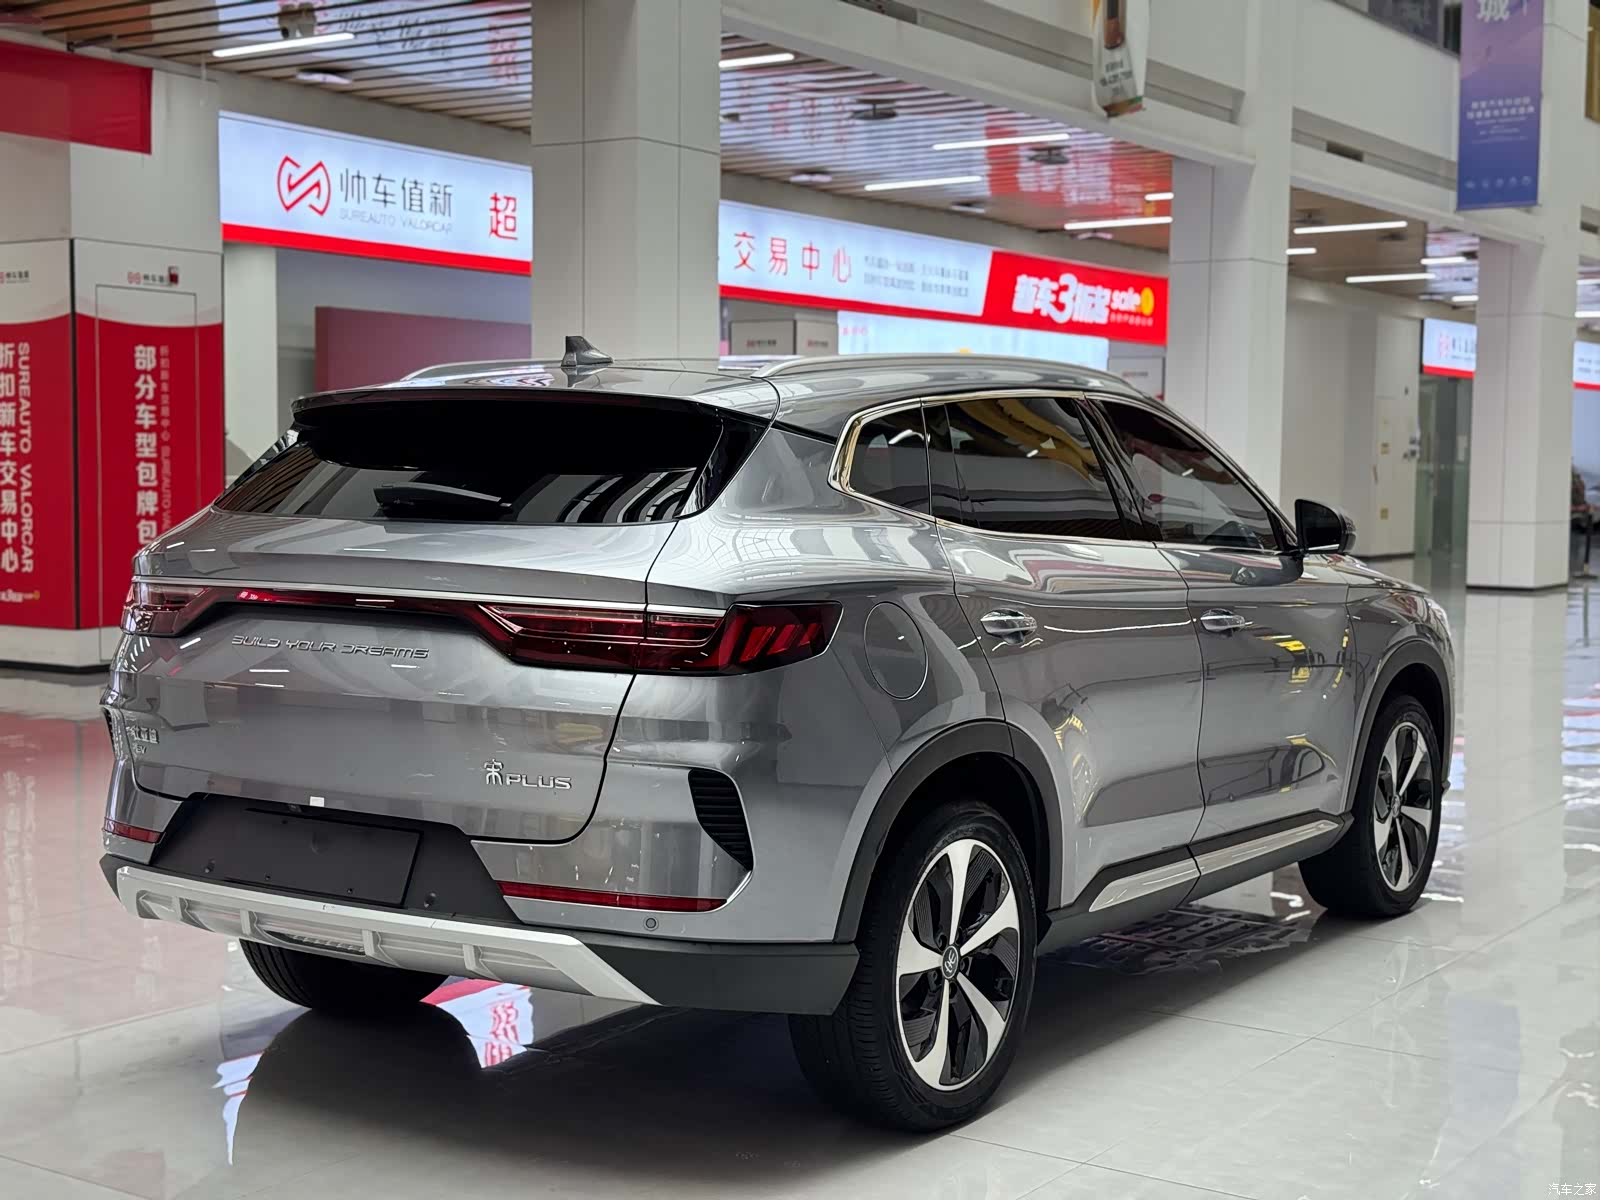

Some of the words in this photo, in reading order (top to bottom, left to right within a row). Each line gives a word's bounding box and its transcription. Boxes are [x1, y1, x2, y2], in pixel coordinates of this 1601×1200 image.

[339, 168, 454, 218] 帅车值新
[489, 192, 518, 241] 超
[734, 231, 852, 283] 交易中心
[18, 342, 32, 454] SUREAUTO
[134, 345, 158, 545] 部分车型包牌包
[20, 464, 33, 573] VALORCAR
[231, 635, 281, 649] BUILD
[285, 638, 338, 653] YOUR
[341, 644, 429, 659] DREAMS
[506, 773, 572, 790] PLUS
